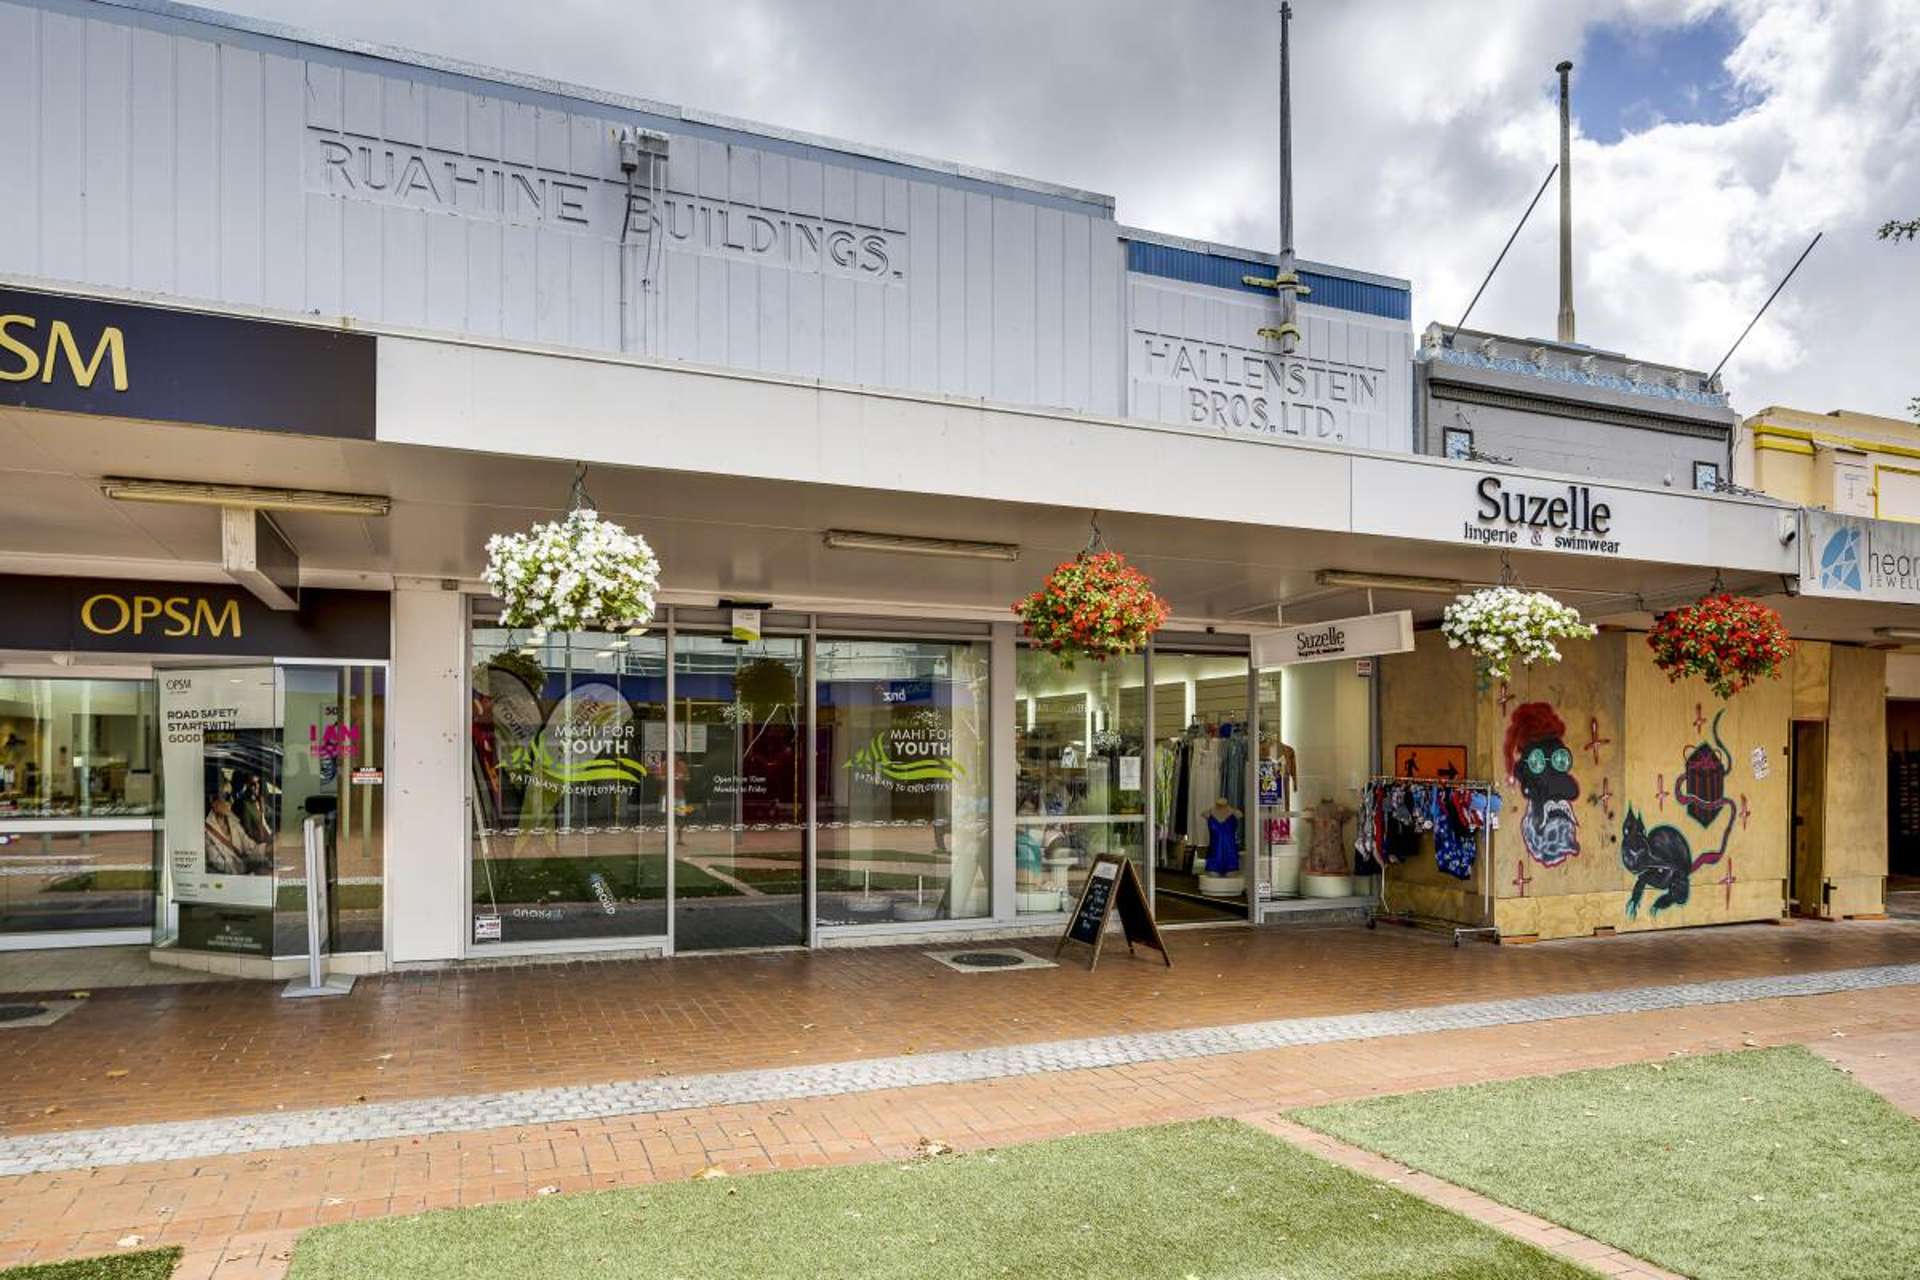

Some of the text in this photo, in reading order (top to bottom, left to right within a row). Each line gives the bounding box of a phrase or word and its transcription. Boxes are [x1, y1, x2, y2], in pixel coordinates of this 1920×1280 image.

[318, 138, 589, 224] RUAHINE
[624, 193, 903, 279] BUILDINGS.
[0, 314, 129, 392] SM
[1144, 339, 1378, 406] HALLENSTEIN
[1477, 476, 1611, 534] Suzelle
[1464, 521, 1621, 554] lingerie & swimwear
[81, 594, 242, 638] OPSM
[1297, 626, 1344, 650] Suzelle
[167, 708, 239, 719] ROAD SAFETY
[168, 734, 200, 743] GOOD
[555, 726, 635, 738] MAHI FOR
[890, 728, 925, 740] MAHI
[559, 740, 629, 754] YOUTH
[894, 742, 951, 755] YOUTH
